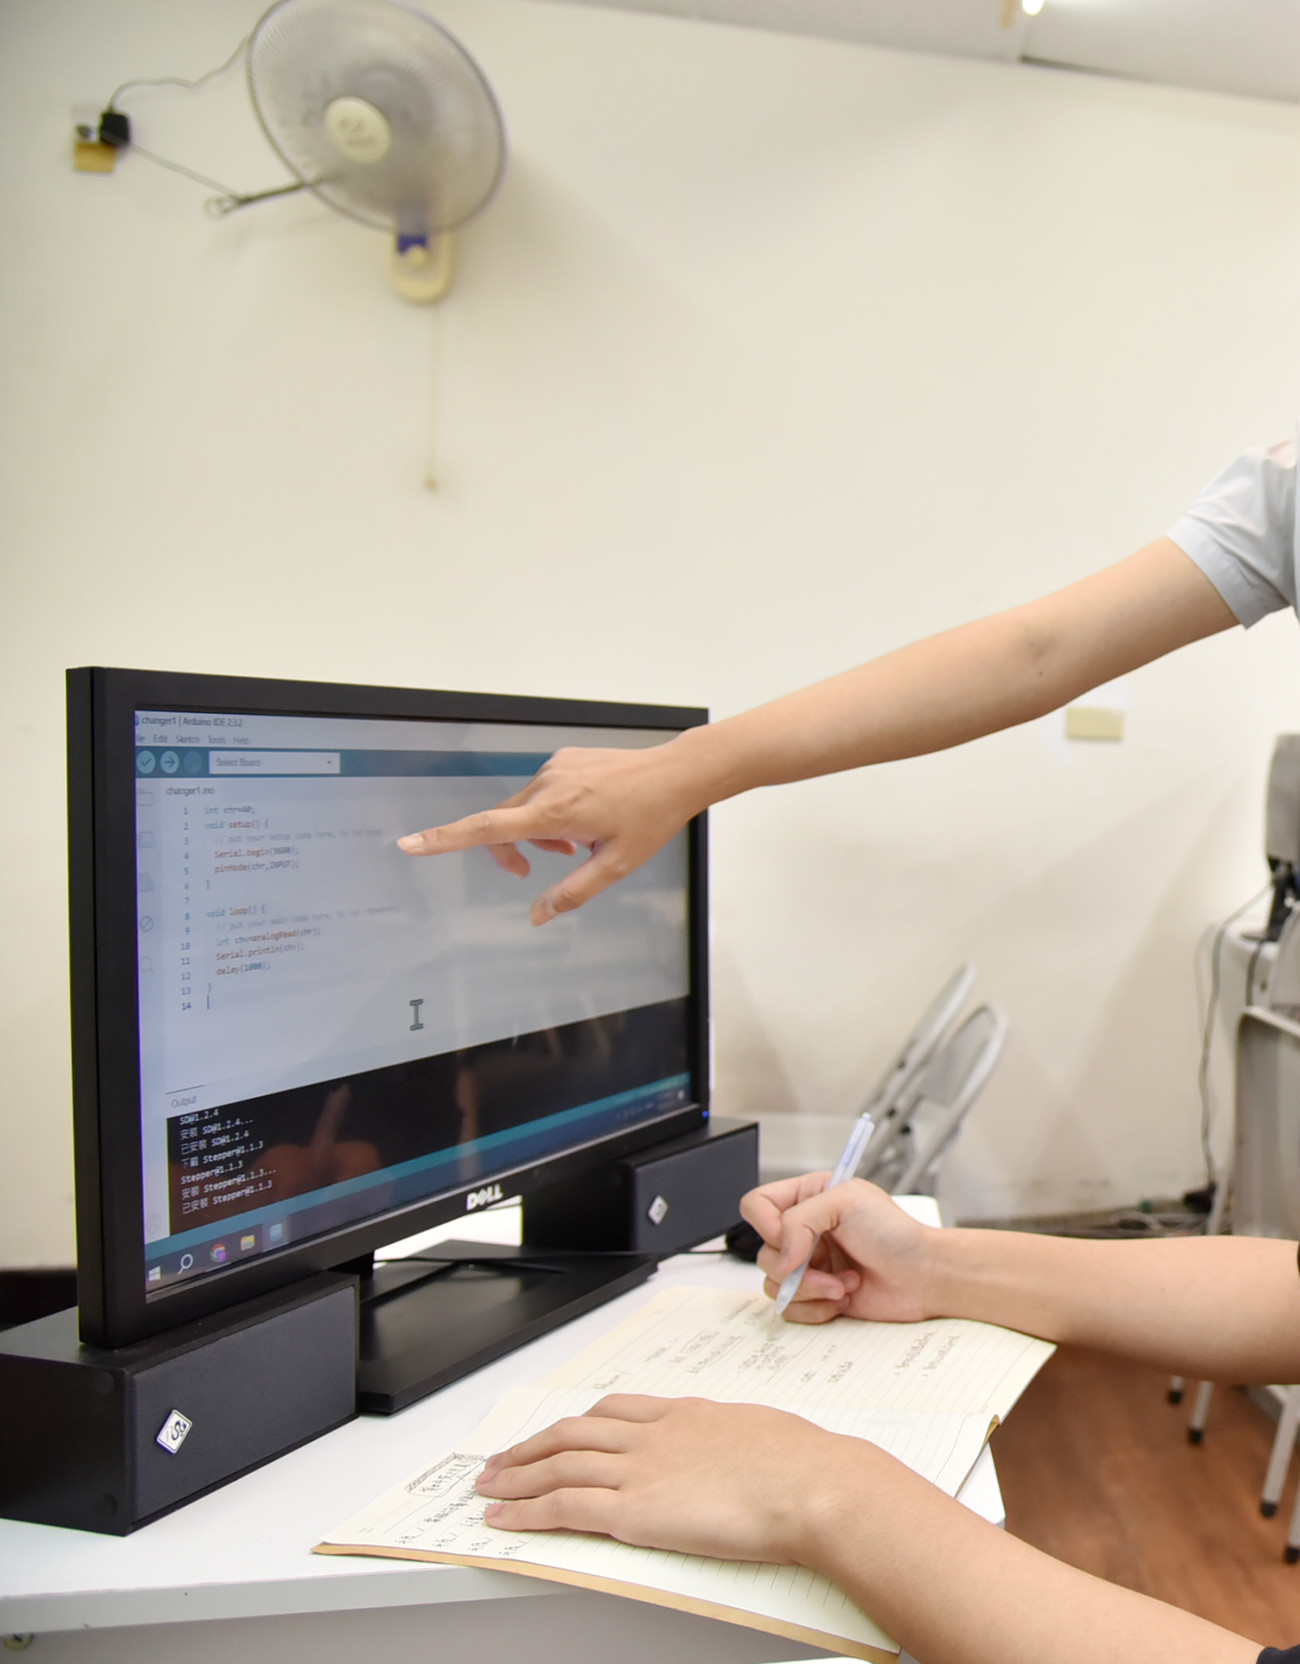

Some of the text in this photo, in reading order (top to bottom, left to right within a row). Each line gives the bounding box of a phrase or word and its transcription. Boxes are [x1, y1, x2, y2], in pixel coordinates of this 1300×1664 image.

[141, 716, 176, 727] changer1
[183, 717, 212, 727] Arduino
[213, 718, 226, 727] IDE
[227, 718, 243, 728] 2.3.2
[153, 734, 168, 744] Edit
[176, 734, 200, 744] Sketch
[208, 735, 226, 745] Tools
[233, 735, 250, 746] Help
[215, 758, 262, 768] Select Board
[166, 785, 215, 797] changer1.ino
[205, 805, 219, 815] int
[183, 822, 189, 831] 2
[205, 819, 225, 829] void
[228, 819, 260, 830] setup()
[183, 837, 189, 846] 3
[183, 852, 189, 861] 4
[183, 867, 189, 876] 5
[183, 882, 189, 891] 6
[184, 912, 190, 921] 8
[206, 908, 225, 918] void
[229, 904, 257, 916] loop()
[184, 927, 190, 936] 9
[180, 942, 190, 951] 10
[216, 937, 230, 947] int
[180, 957, 190, 966] 11
[181, 972, 191, 981] 12
[181, 986, 191, 995] 13
[181, 1001, 192, 1011] 14
[172, 1096, 197, 1110] Output
[180, 1109, 219, 1125] SD@1.2.4
[212, 1130, 250, 1147] SD@1.2.4
[203, 1140, 264, 1164] Stepper@1.1.3
[181, 1160, 243, 1185] Stepper@1.1.3
[212, 1180, 273, 1206] Stepper@1.1.3
[465, 1182, 504, 1212] DELL
